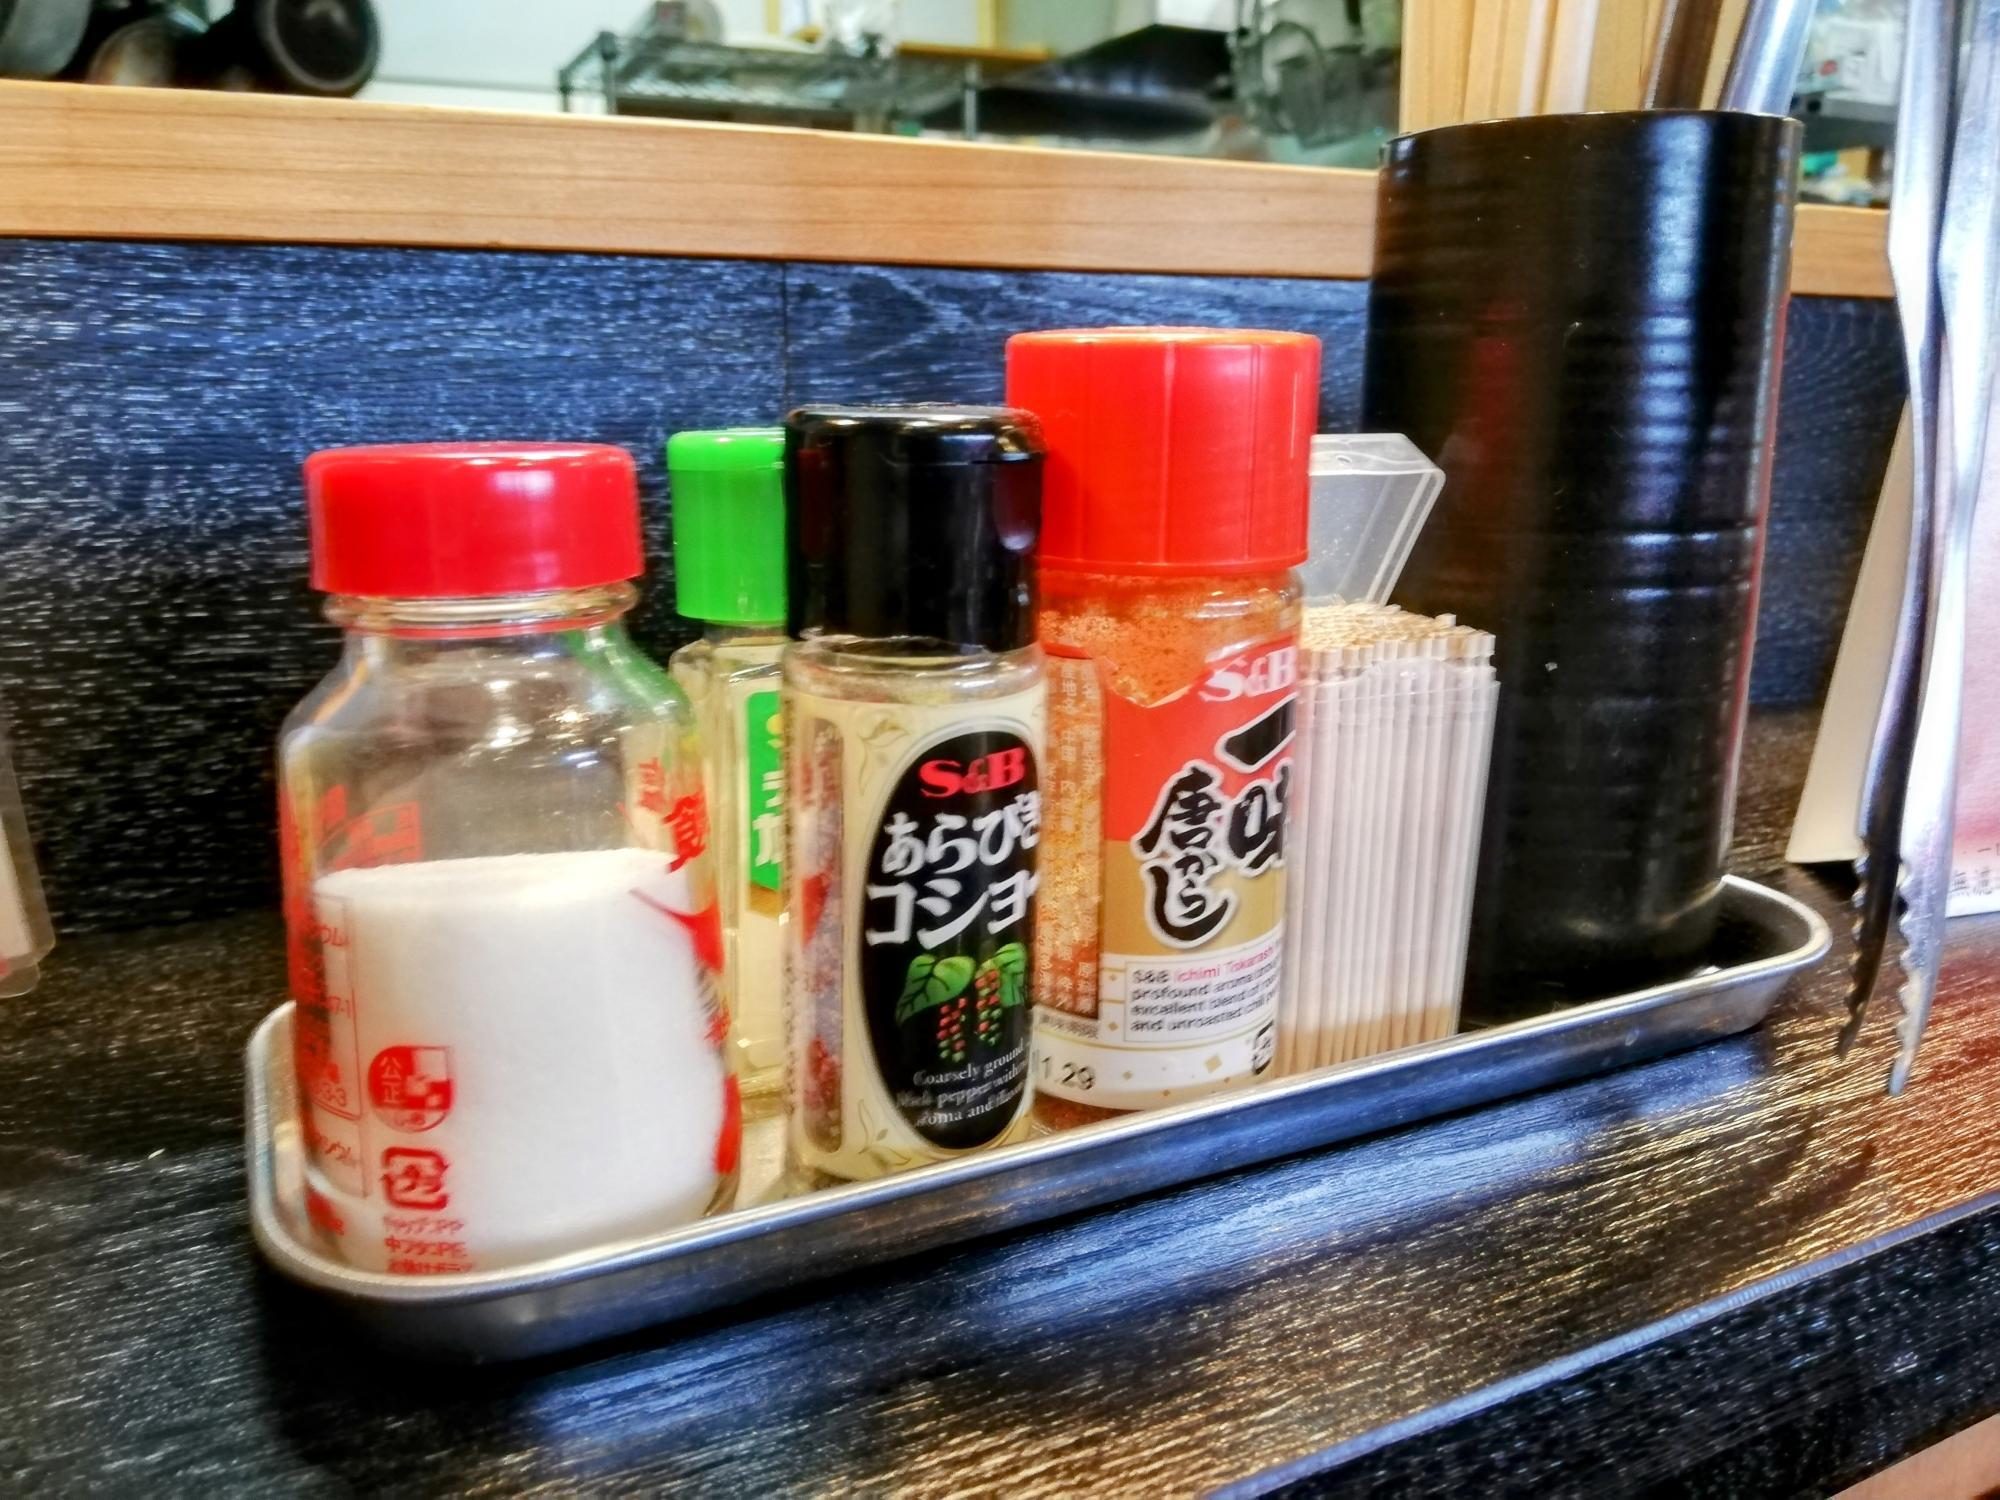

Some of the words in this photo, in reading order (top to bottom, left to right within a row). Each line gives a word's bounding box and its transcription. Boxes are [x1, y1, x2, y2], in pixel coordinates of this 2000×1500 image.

[1198, 646, 1296, 702] S&B
[919, 747, 1026, 798] S&B
[913, 1063, 981, 1087] Coarsely
[983, 1037, 1025, 1079] ground
